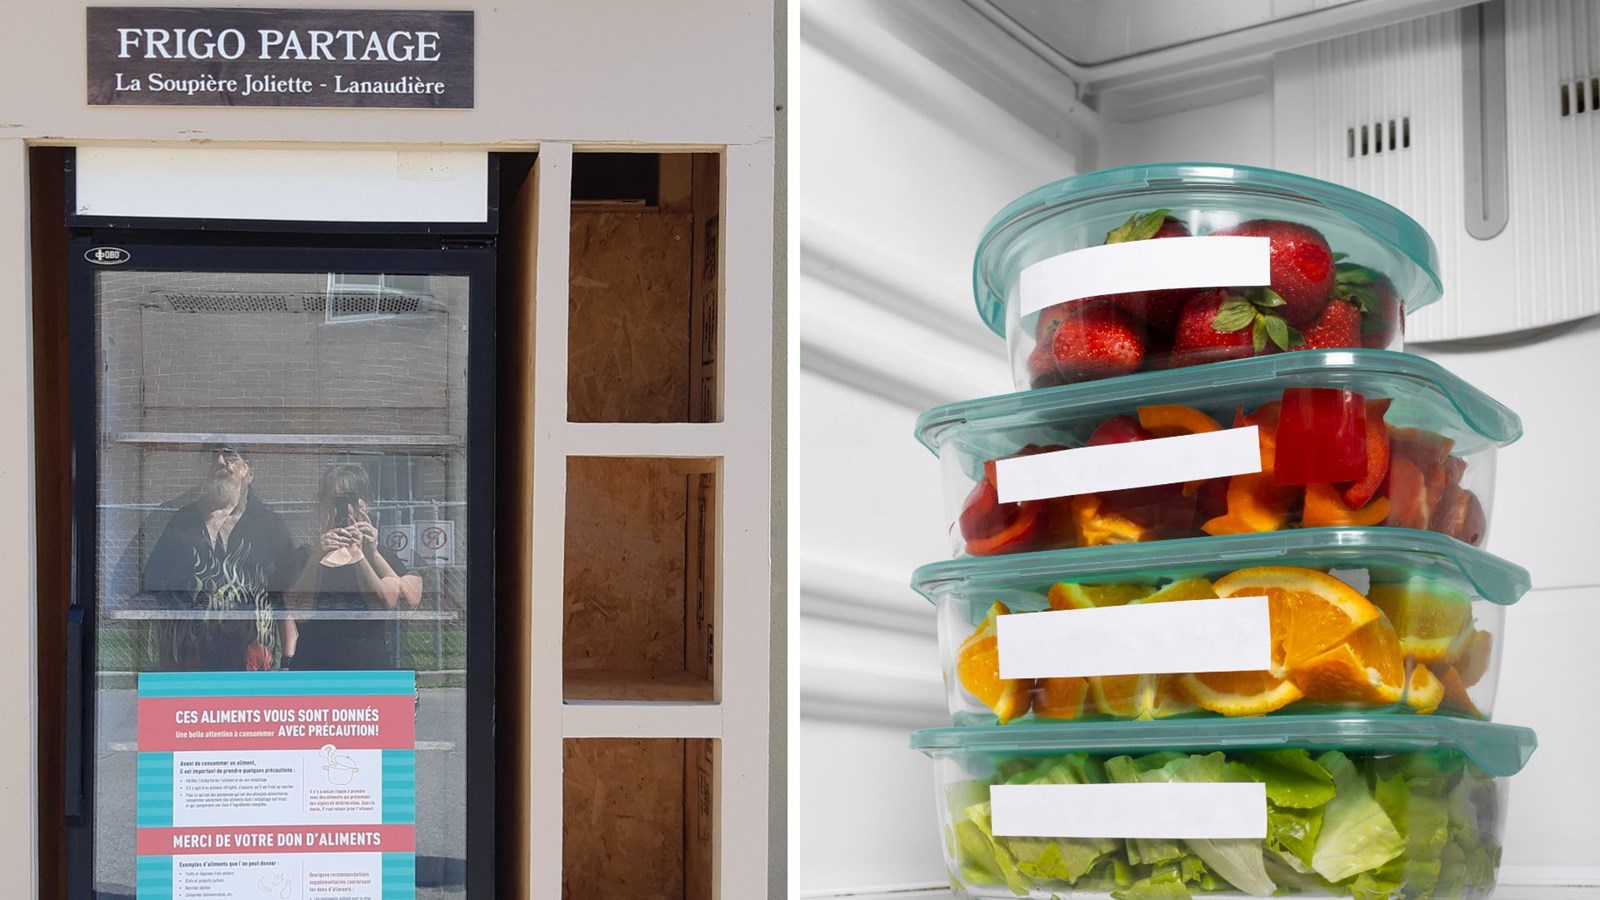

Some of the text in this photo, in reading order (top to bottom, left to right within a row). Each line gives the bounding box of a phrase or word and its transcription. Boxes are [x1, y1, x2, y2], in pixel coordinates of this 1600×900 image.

[117, 28, 441, 62] FRIGO PARTAGE
[116, 73, 140, 91] La
[149, 74, 236, 95] Soupière
[242, 75, 312, 95] Joliette
[335, 75, 445, 94] Lanaudière
[176, 706, 379, 724] CES ALIMENTS VOUS SONT DONNÉS
[189, 730, 204, 738] belle
[205, 730, 233, 738] attention
[278, 725, 305, 737] AVEC
[308, 722, 379, 736] PRÉCAUTION!
[173, 831, 381, 848] MERCI DE VOTRE DON D'ALIMENTS
